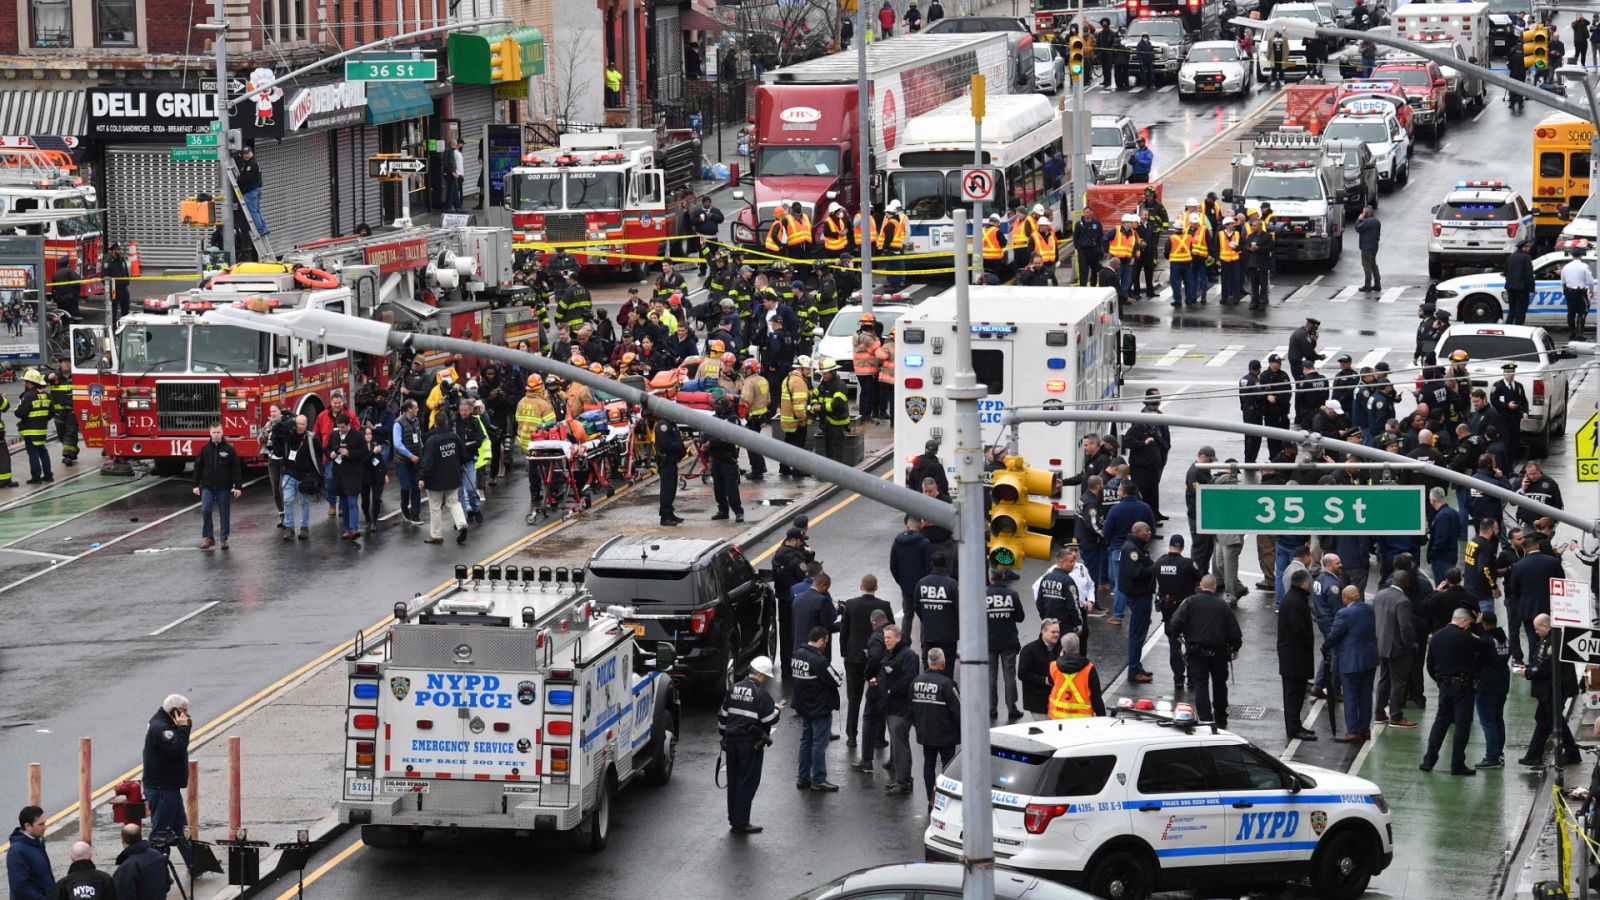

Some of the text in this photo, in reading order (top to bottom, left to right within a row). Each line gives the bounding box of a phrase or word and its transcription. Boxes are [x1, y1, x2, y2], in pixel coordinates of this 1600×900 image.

[369, 64, 414, 77] 36 St
[92, 92, 146, 117] DELI
[293, 90, 311, 126] KING
[191, 136, 202, 145] 36
[1568, 131, 1592, 141] SCHOO
[368, 250, 388, 265] LADDER
[405, 244, 418, 260] TALLY
[977, 400, 1004, 411] YPD
[127, 416, 156, 428] F.D.
[979, 412, 1002, 423] LIC
[170, 440, 193, 456] 114
[440, 442, 456, 451] NYPD
[1255, 496, 1367, 524] 35 St
[1042, 579, 1063, 591] NYPD
[920, 585, 947, 599] PBA
[924, 603, 944, 611] NYPD
[986, 594, 1014, 608] PBA
[1578, 638, 1600, 654] ON
[596, 655, 616, 691] POLICE
[427, 673, 500, 691] NYPD
[733, 686, 752, 697] MTA
[415, 691, 513, 709] POLICE
[412, 739, 514, 754] EMERGENCY SERVICE
[352, 782, 371, 792] 5751
[941, 779, 958, 791] NYPD
[1341, 794, 1365, 804] POLICE
[1078, 803, 1092, 812] 4395
[1111, 801, 1122, 810] K-9
[1235, 811, 1300, 840] NYPD
[73, 885, 96, 897] NYPD
